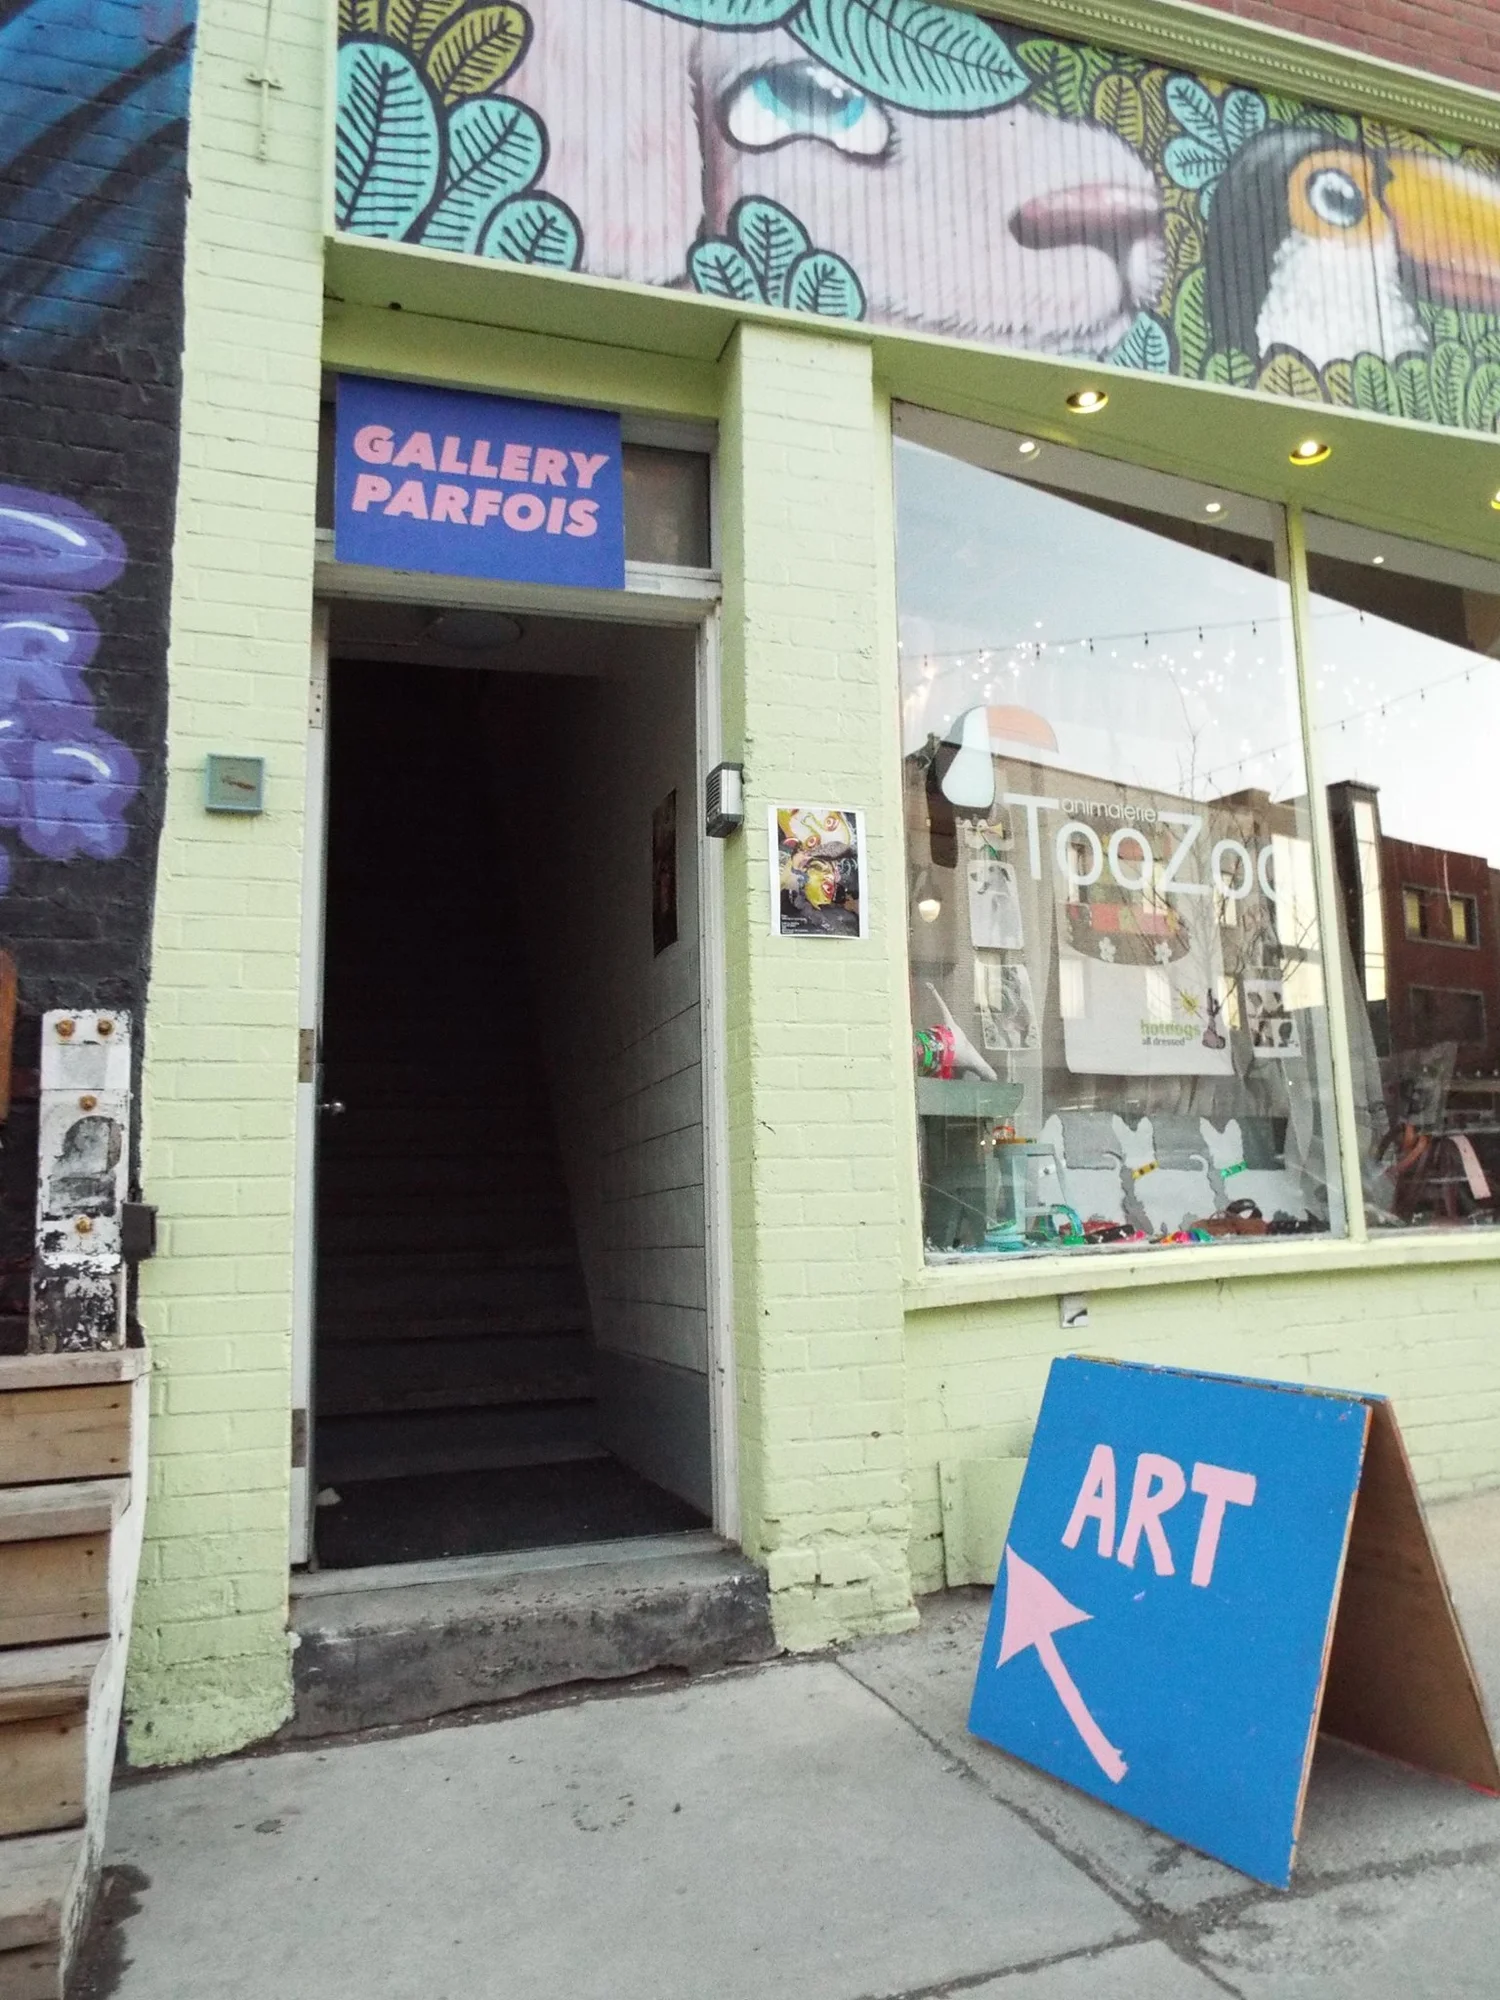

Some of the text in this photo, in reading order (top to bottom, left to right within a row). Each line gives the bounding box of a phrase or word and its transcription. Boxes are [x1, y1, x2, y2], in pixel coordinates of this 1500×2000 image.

[353, 424, 610, 489] GALLERY
[351, 473, 600, 538] PARFOIS
[1061, 797, 1159, 824] animalerie
[1060, 1443, 1257, 1588] ART
